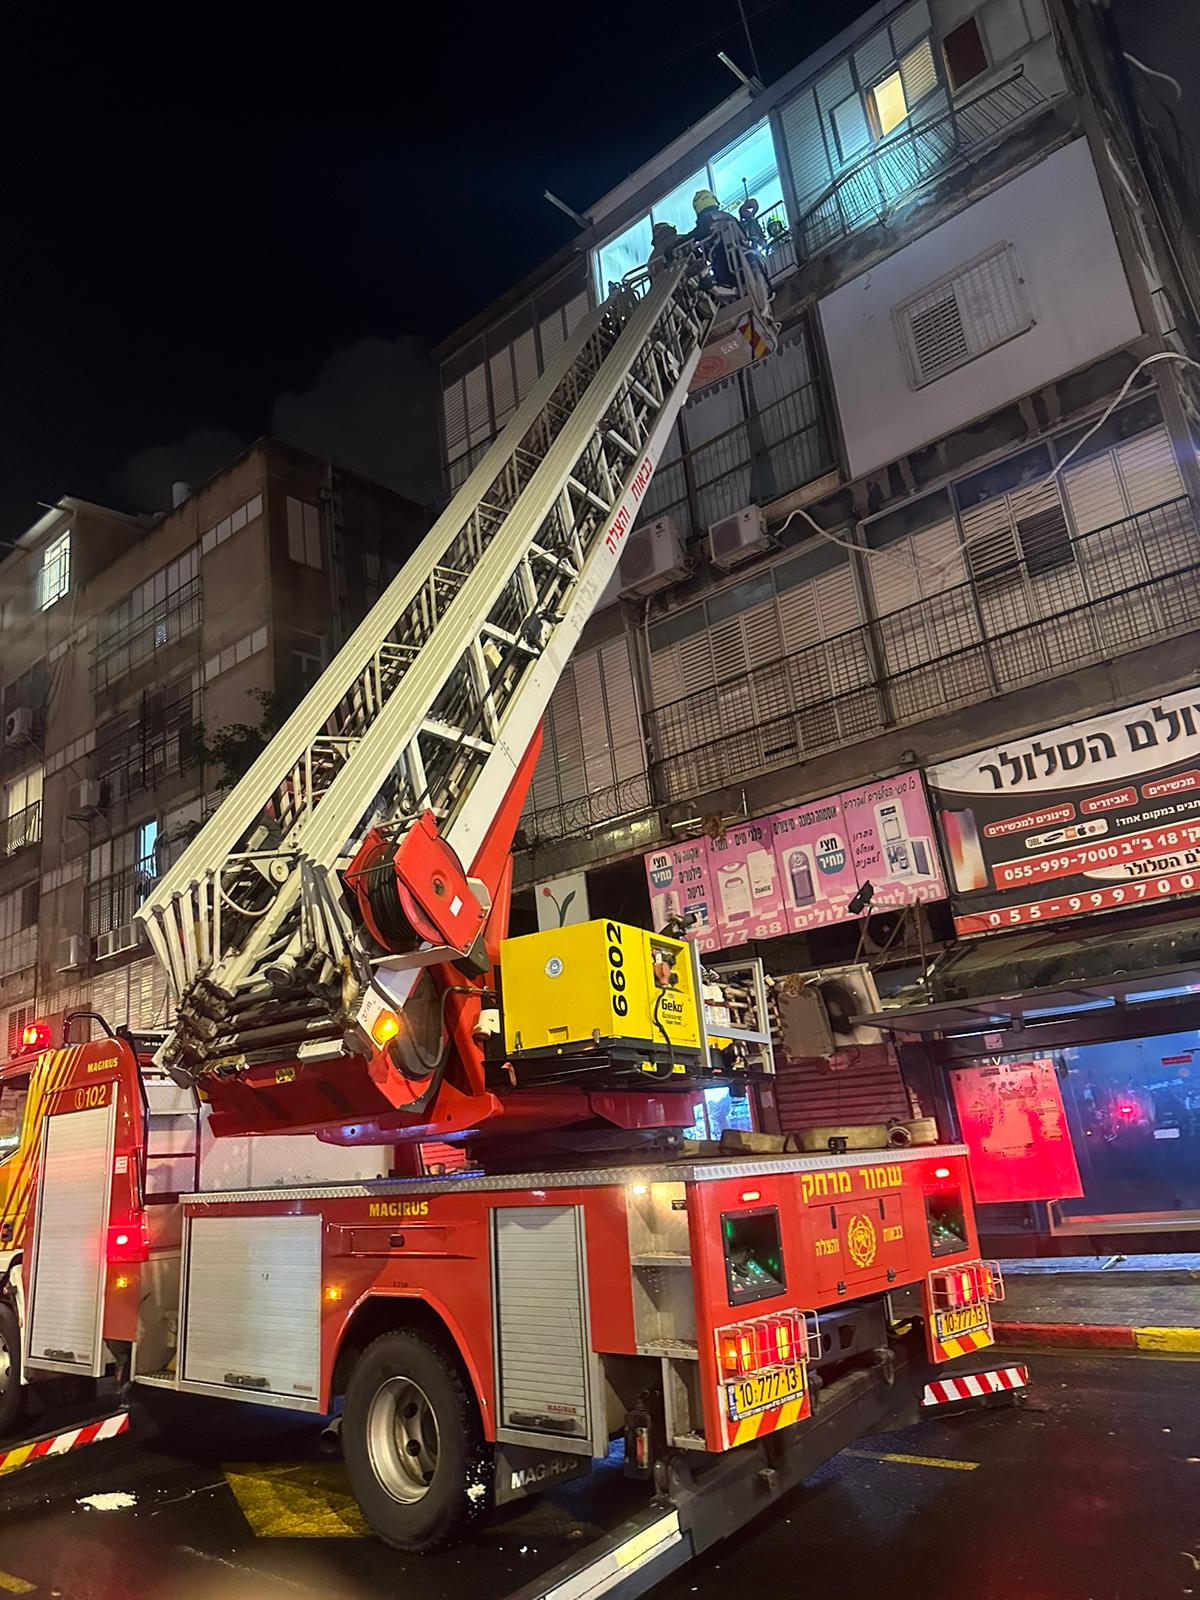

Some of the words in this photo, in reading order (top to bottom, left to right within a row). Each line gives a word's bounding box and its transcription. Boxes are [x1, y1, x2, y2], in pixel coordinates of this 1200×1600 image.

[630, 456, 653, 502] כבאות
[605, 505, 631, 555] והצלה
[978, 731, 1117, 790] הסלולר
[1148, 776, 1196, 796] מכשירים
[1088, 793, 1129, 811] אביזרים
[1115, 814, 1142, 827] אחד!
[1142, 806, 1175, 820] במקום
[988, 816, 1034, 835] למכשירים
[820, 837, 838, 852] חצי
[1157, 832, 1179, 846] 18
[653, 855, 667, 868] חצי
[819, 853, 844, 868] מחיר
[1004, 845, 1119, 881] 055-999-7000
[1123, 855, 1181, 876] הסלולר
[651, 871, 672, 884] מחיר
[907, 882, 943, 905] הכל
[722, 929, 749, 944] 77
[755, 921, 782, 937] 88
[606, 921, 628, 1017] 6602
[661, 998, 683, 1013] Geko
[87, 1057, 119, 1073] MAGIRUS
[85, 1084, 107, 1108] 102
[801, 1171, 853, 1204] מרחק
[859, 1166, 903, 1190] שמור
[369, 1201, 429, 1217] MAGIRUS
[546, 1404, 577, 1414] MAGIRUS
[510, 1458, 579, 1490] MAGIRUS
